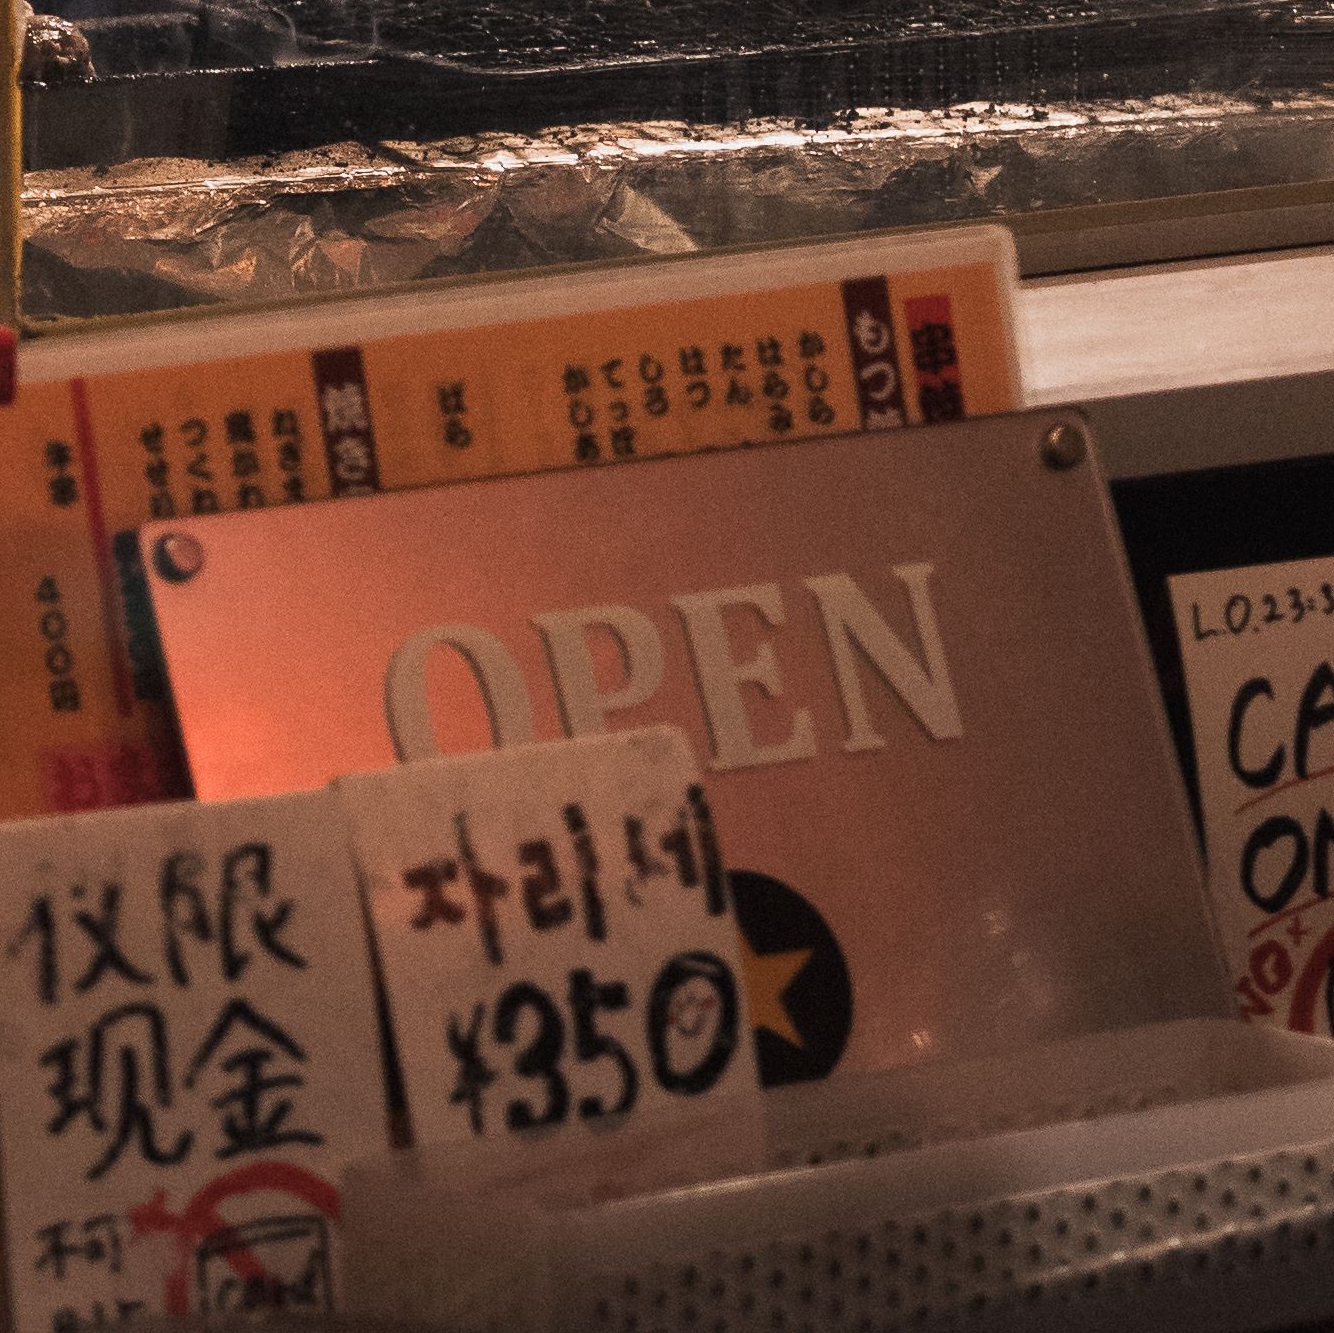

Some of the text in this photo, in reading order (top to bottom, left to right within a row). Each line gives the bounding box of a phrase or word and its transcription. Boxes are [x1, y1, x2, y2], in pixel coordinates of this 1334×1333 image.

[383, 560, 967, 774] OPEN
[10, 840, 309, 1005] 仅限
[37, 997, 325, 1183] 现金
[447, 949, 741, 1134] ¥350
